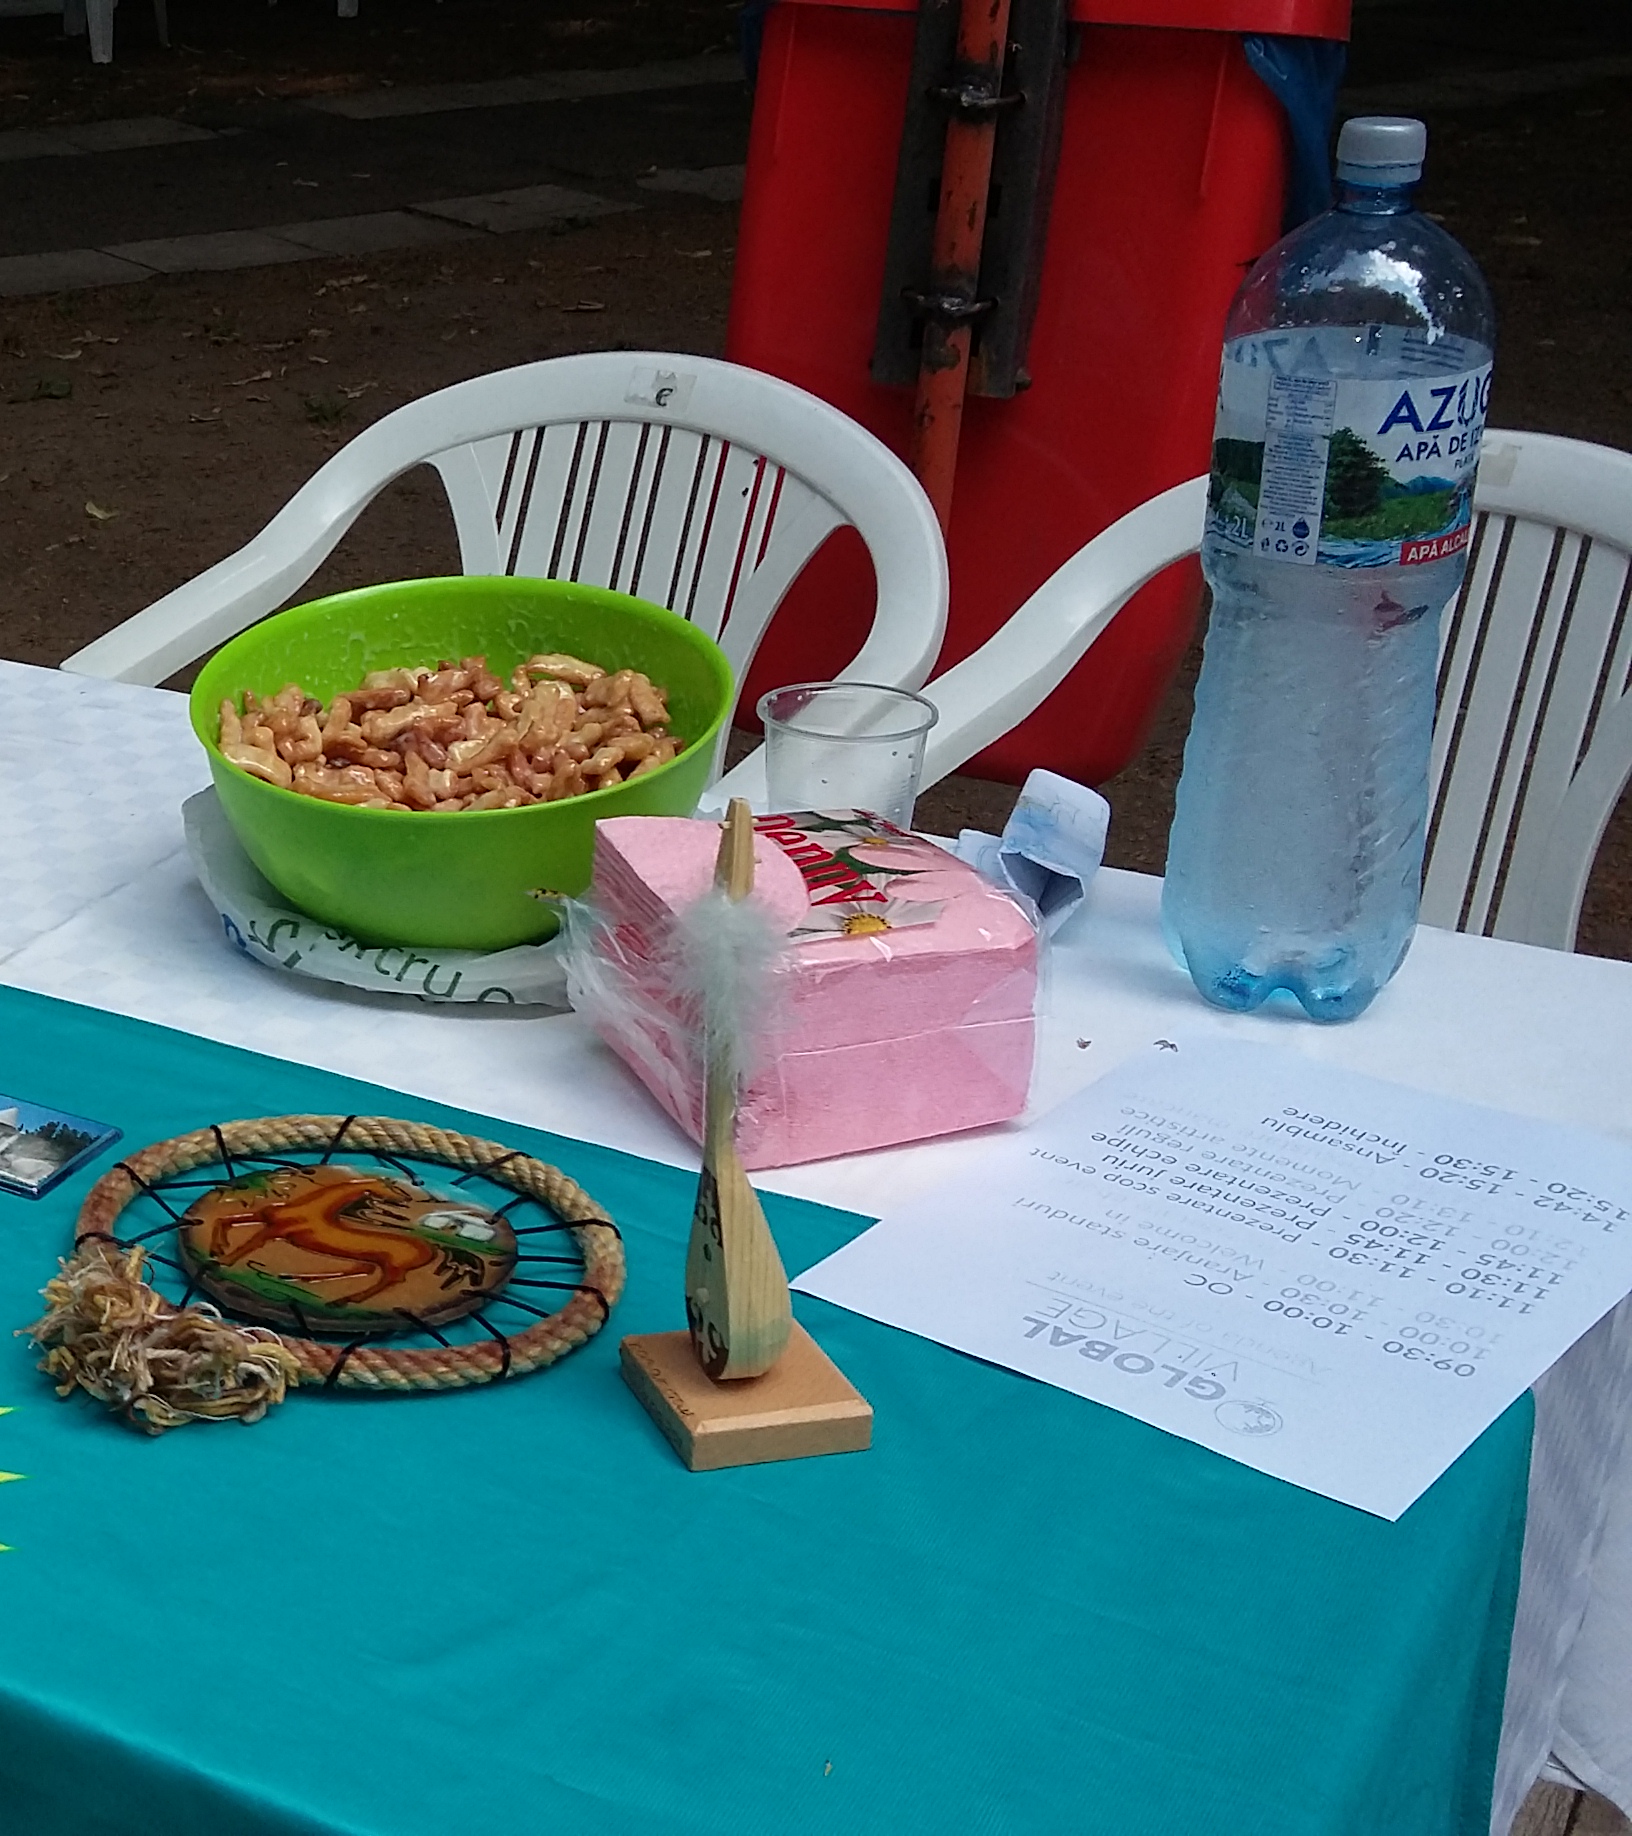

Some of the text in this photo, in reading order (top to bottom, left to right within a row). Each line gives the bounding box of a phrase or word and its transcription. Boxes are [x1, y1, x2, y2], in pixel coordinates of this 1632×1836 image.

[1395, 435, 1442, 462] APĂ
[1448, 433, 1469, 455] DE
[1407, 540, 1438, 561] APĂ
[1120, 1106, 1225, 1145] artistice
[1120, 1124, 1194, 1152] reguli
[1260, 1116, 1396, 1164] Ansamblu
[1028, 1147, 1096, 1176] event
[1090, 1131, 1178, 1166] echipe
[1101, 1153, 1168, 1180] juriu
[1201, 1150, 1347, 1204] Prezentare
[1232, 1143, 1362, 1190] Momente
[1418, 1166, 1503, 1195] 15:20
[1434, 1154, 1518, 1181] 15:30
[1104, 1169, 1161, 1198] scop
[1185, 1163, 1332, 1217] Prezentare
[1012, 1196, 1126, 1240] standuri
[1105, 1208, 1131, 1224] in
[1166, 1192, 1302, 1243] Prezentare
[1169, 1176, 1318, 1230] Prezentare
[1533, 1194, 1618, 1233] 14:42
[1546, 1182, 1630, 1222] 15:20
[1360, 1220, 1446, 1251] 12:00
[1375, 1206, 1461, 1237] 12:20
[1133, 1236, 1254, 1282] Aranjare
[1137, 1220, 1265, 1271] Welcome
[1328, 1246, 1416, 1278] 11:30
[1342, 1233, 1431, 1265] 11:45
[1490, 1238, 1578, 1270] 12:00
[1182, 1273, 1233, 1295] OC
[1460, 1267, 1550, 1300] 11:30
[1474, 1254, 1564, 1285] 11:45
[1280, 1286, 1368, 1322] 10:30
[1297, 1274, 1384, 1307] 11:00
[1445, 1282, 1535, 1314] 11:10
[1263, 1300, 1352, 1336] 10:00
[1035, 1297, 1238, 1382] VILLAGE
[1399, 1326, 1490, 1360] 10:00
[1022, 1316, 1226, 1400] GLOBAL
[1382, 1340, 1476, 1377] 09:30
